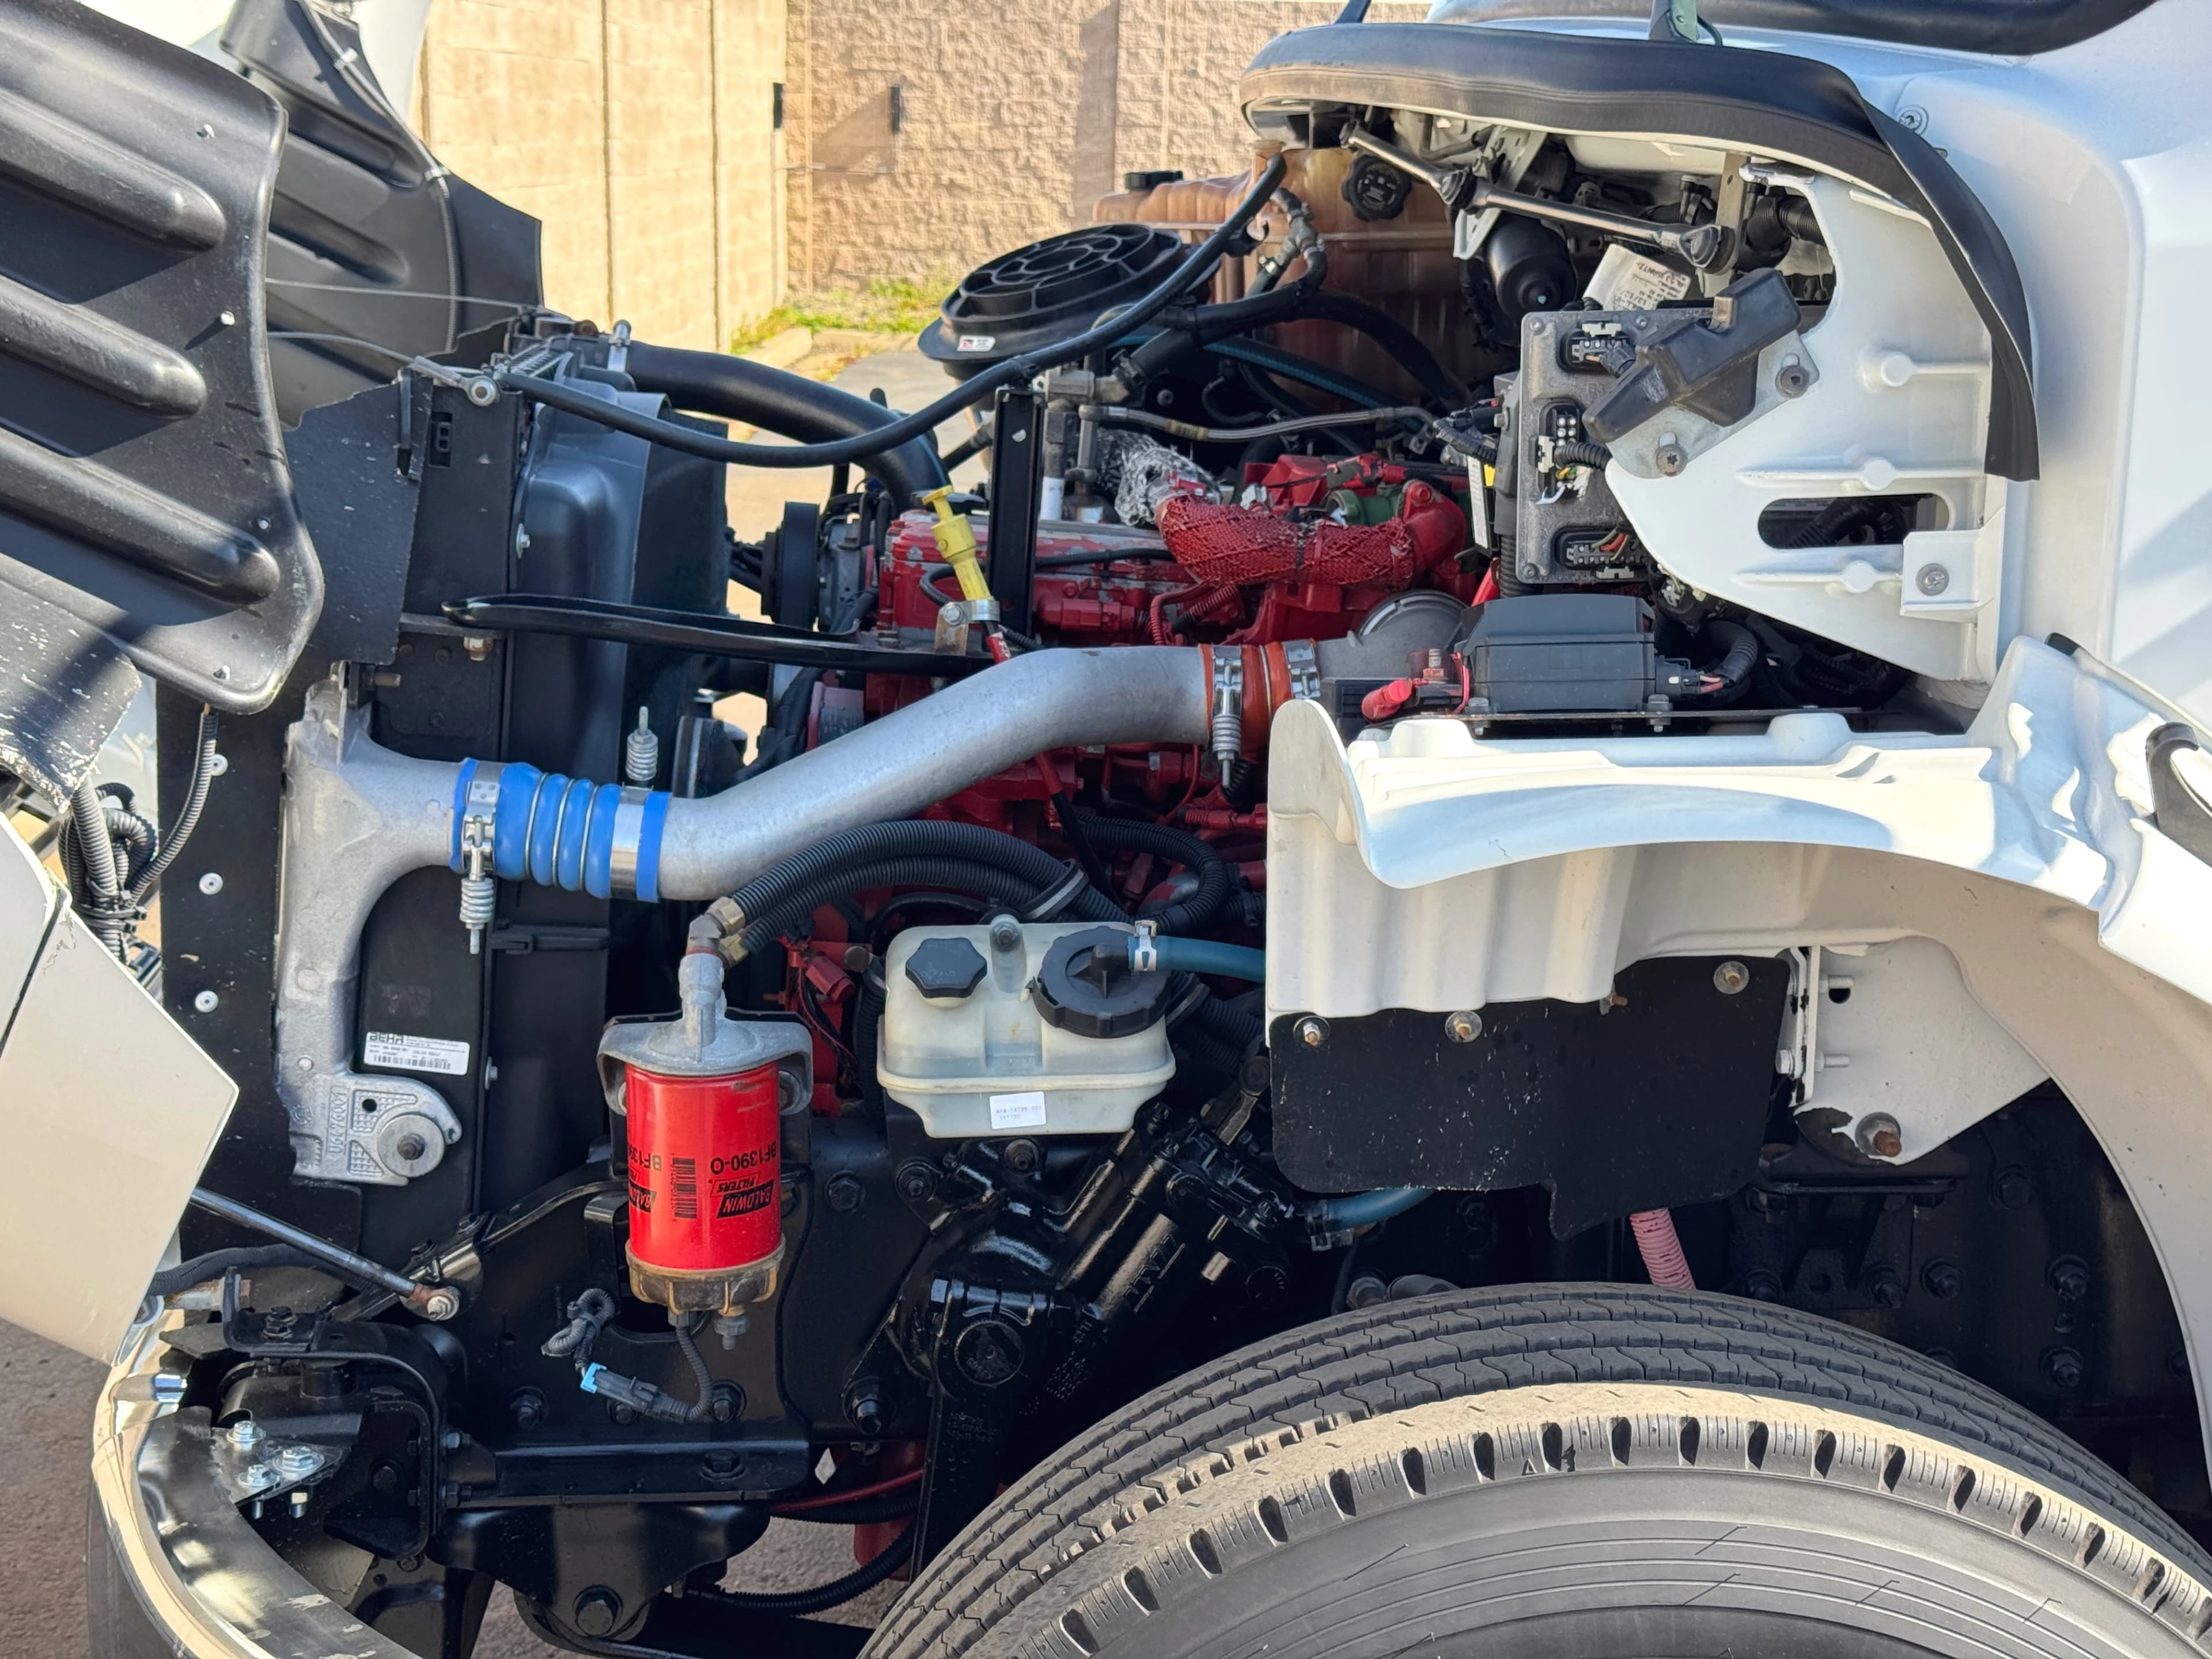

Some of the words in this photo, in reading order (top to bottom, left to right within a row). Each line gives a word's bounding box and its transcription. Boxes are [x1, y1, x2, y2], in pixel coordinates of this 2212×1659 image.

[710, 1140, 776, 1175] BF1390-O
[717, 1176, 756, 1193] FILTERS
[722, 1185, 772, 1213] BALDWIN
